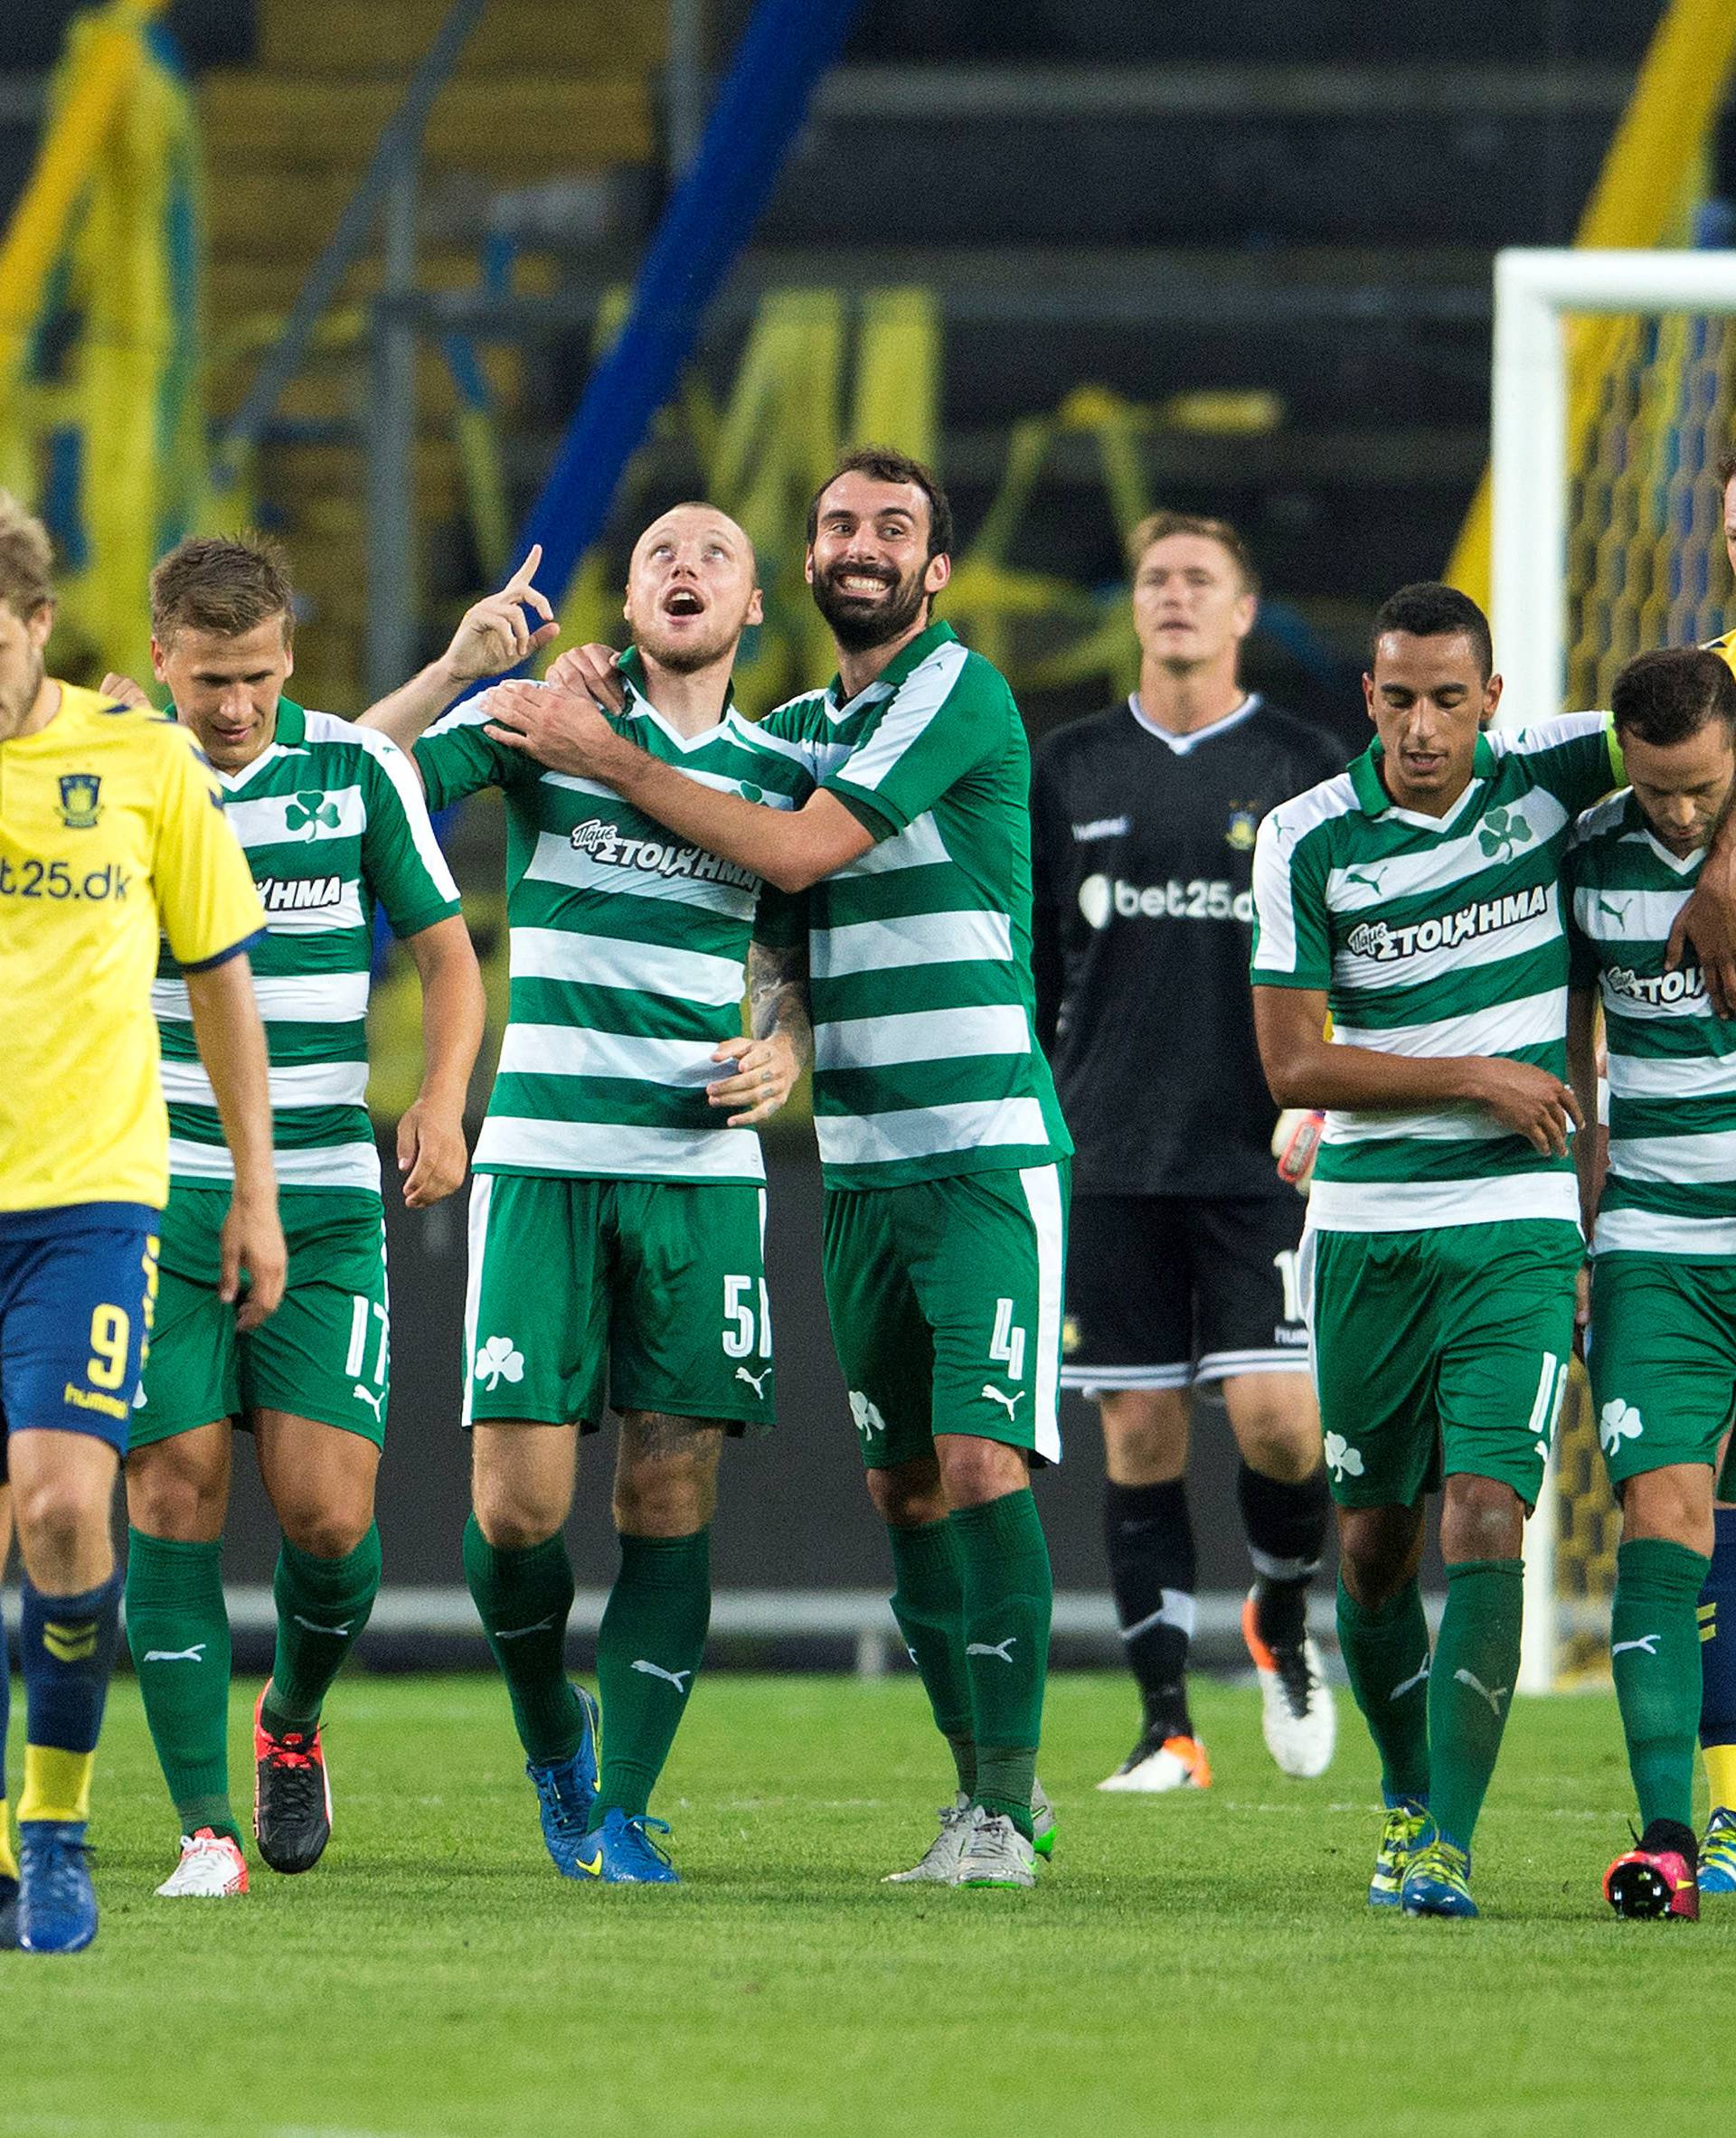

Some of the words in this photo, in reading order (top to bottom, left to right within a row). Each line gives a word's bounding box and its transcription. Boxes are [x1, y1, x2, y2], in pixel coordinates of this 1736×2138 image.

[87, 1302, 130, 1389] 9
[345, 1295, 390, 1386] 17
[722, 1274, 772, 1358] 51
[989, 1297, 1025, 1380] 4
